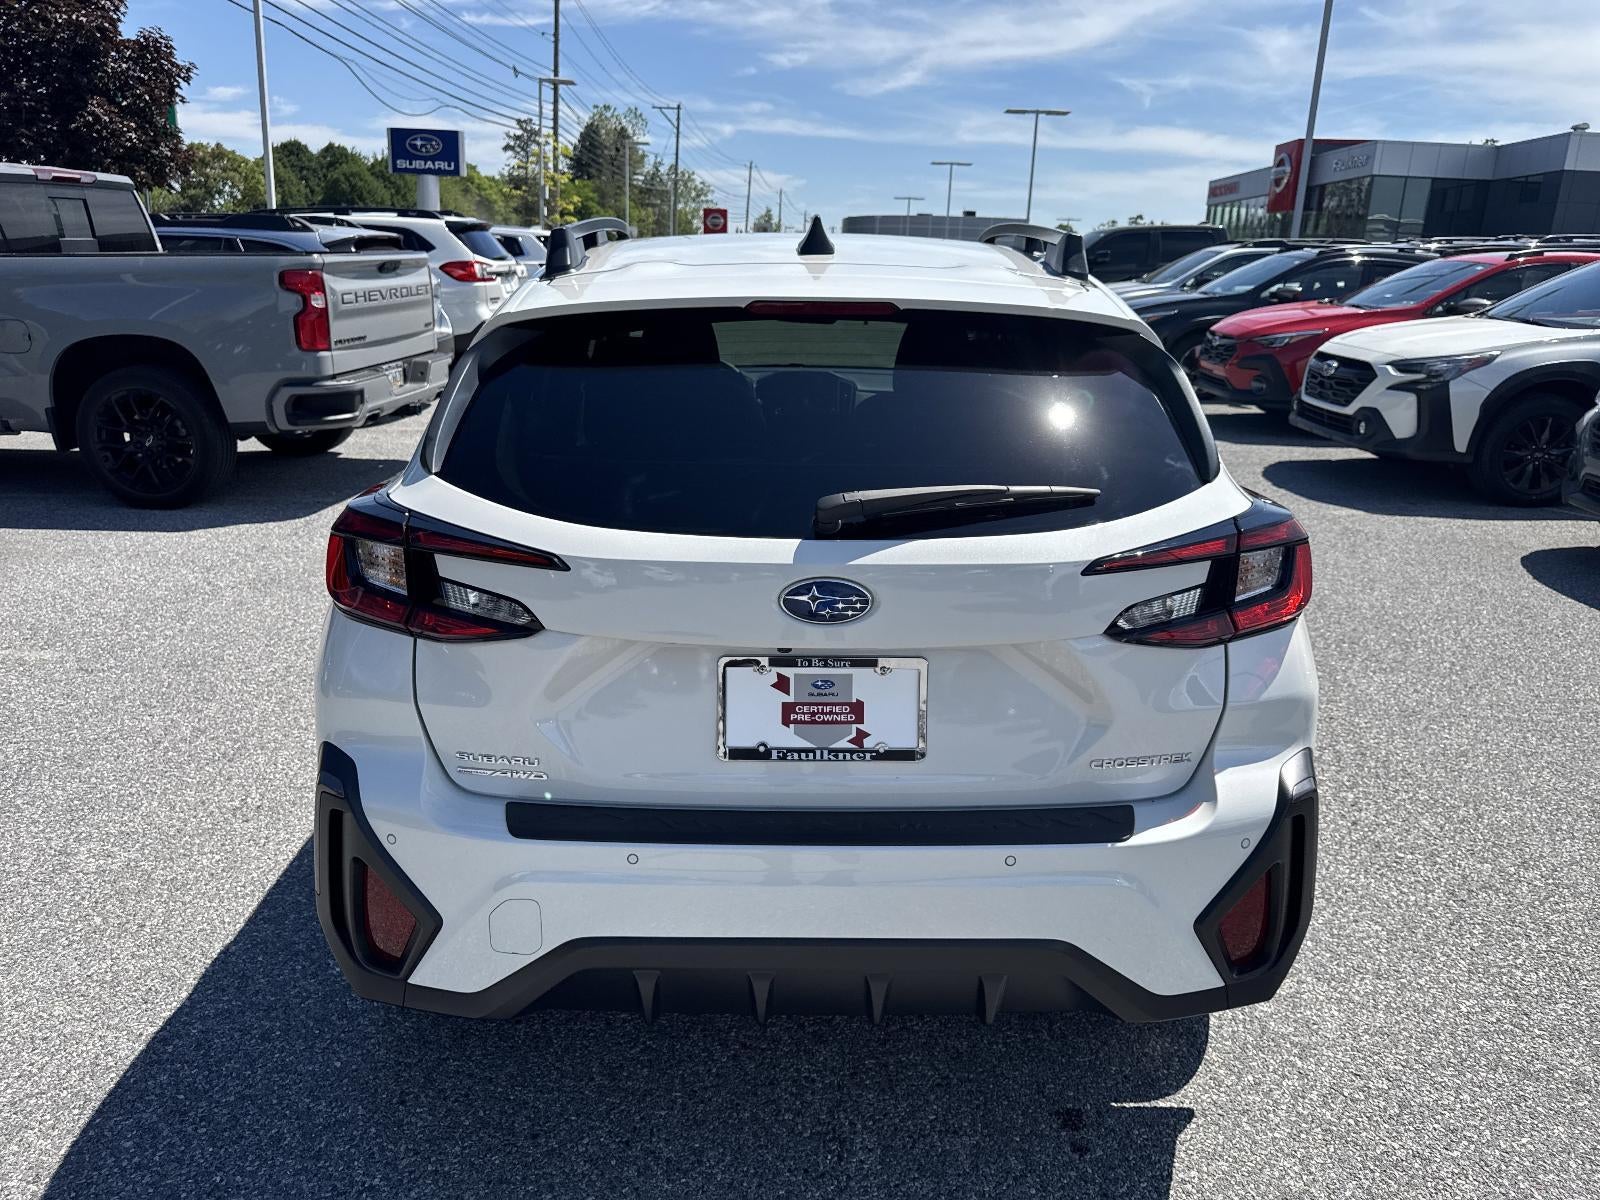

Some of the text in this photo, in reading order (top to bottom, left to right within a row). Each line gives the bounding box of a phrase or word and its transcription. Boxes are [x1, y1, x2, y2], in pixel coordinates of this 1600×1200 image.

[396, 159, 455, 171] SUBARU
[341, 284, 430, 305] CHEVROLET
[796, 658, 851, 668] To Be Sure
[795, 705, 850, 714] CERTIFIED
[790, 714, 855, 722] PRE-OWNED
[455, 751, 540, 767] SUBARU
[769, 749, 877, 761] Faulkner
[1090, 752, 1193, 769] CROSSTREK
[491, 769, 548, 780] AWD
